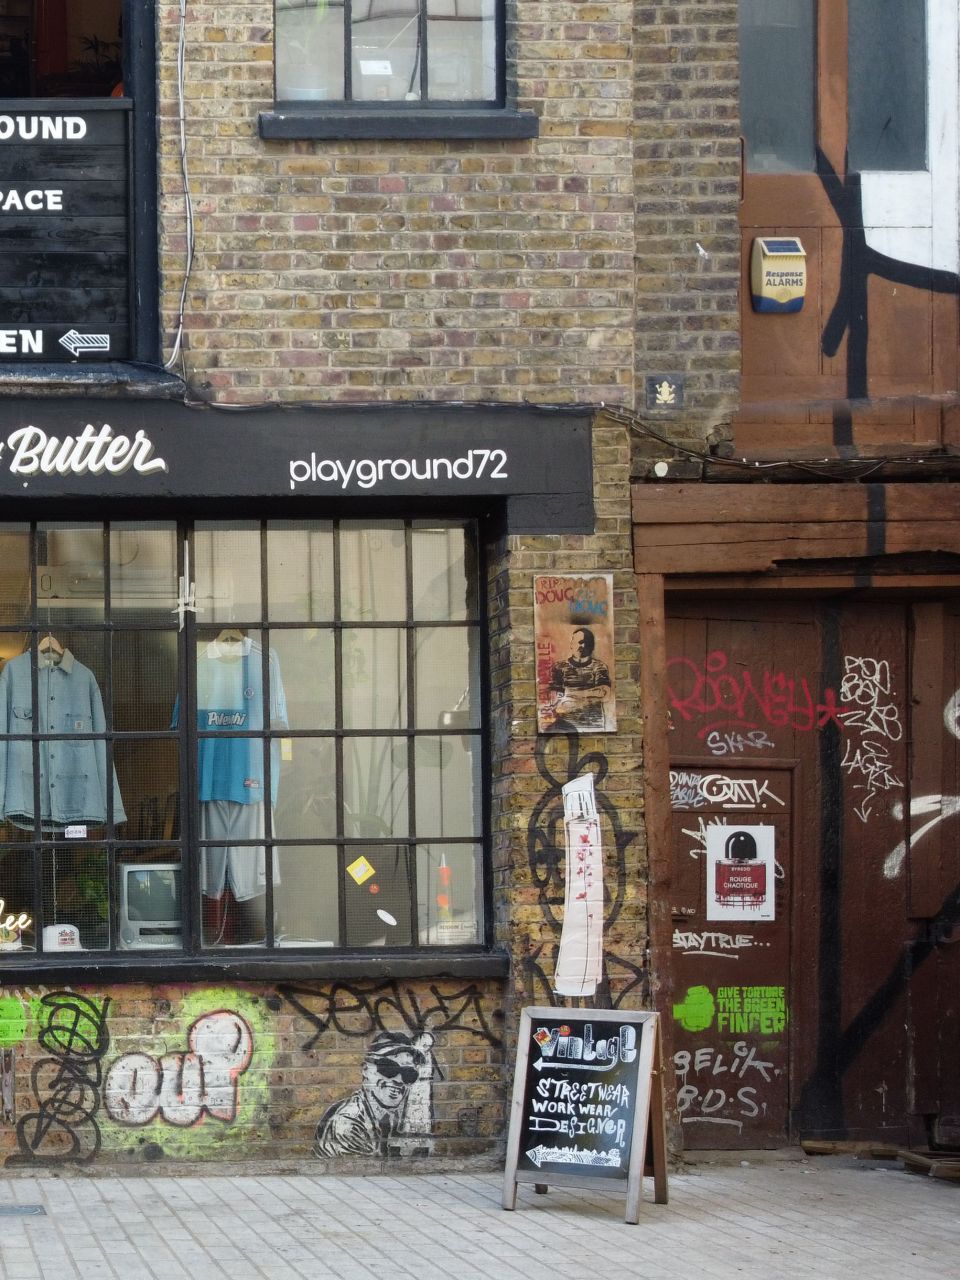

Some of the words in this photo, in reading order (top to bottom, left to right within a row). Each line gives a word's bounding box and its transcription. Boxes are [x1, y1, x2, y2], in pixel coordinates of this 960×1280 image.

[766, 270, 804, 279] Response
[766, 278, 804, 287] ALARMS
[7, 424, 168, 477] Butter
[289, 449, 509, 490] playground72
[717, 986, 740, 998] GIVE
[717, 998, 742, 1012] THE
[743, 997, 785, 1013] GREEN
[537, 1024, 637, 1064] Vintage
[531, 1098, 575, 1116] WORK
[578, 1102, 619, 1117] WEAR
